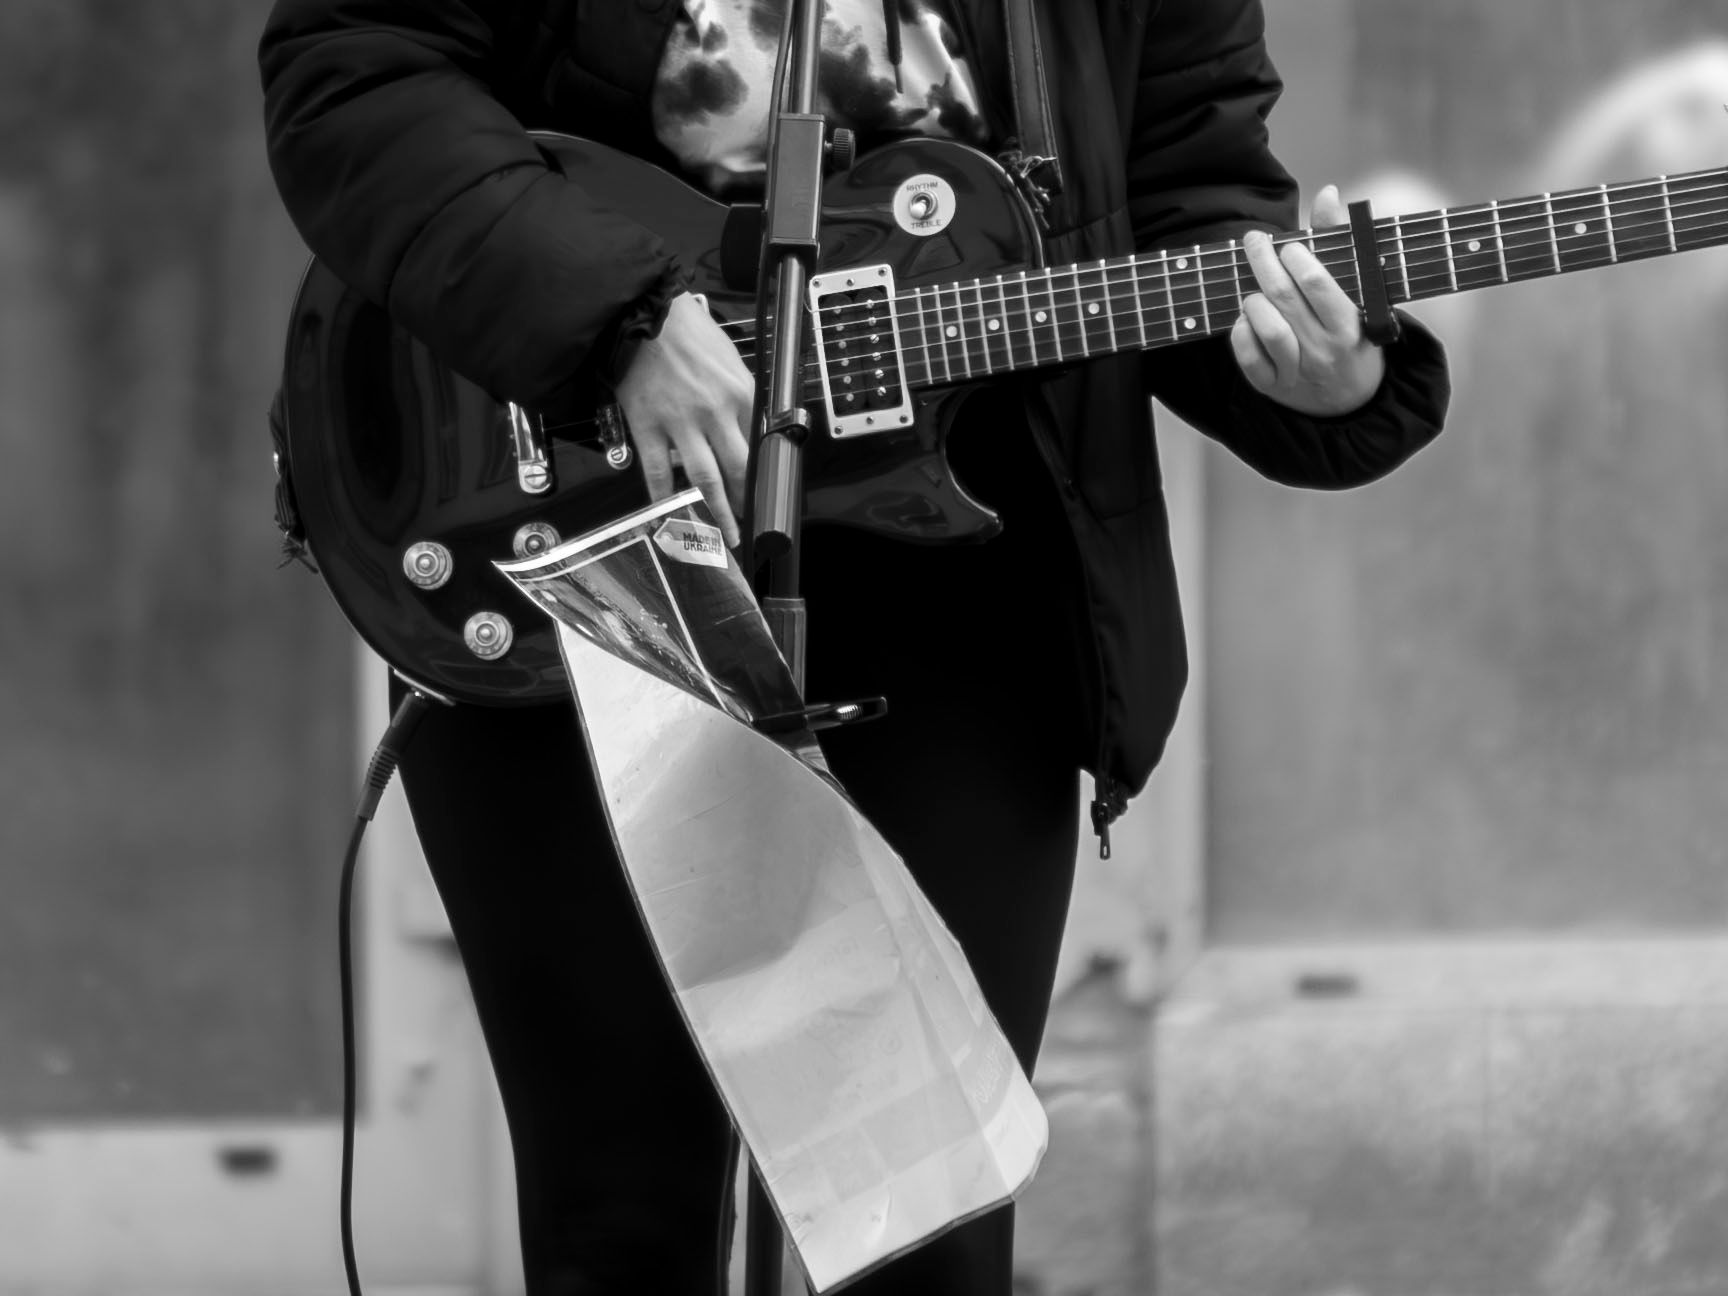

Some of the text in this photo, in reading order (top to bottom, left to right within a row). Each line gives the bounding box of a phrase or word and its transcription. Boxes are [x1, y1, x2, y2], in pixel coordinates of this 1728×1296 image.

[906, 182, 938, 192] RHYTHM
[912, 219, 942, 229] TREBLE
[683, 531, 710, 546] MADE
[683, 541, 723, 557] UKRAINE
